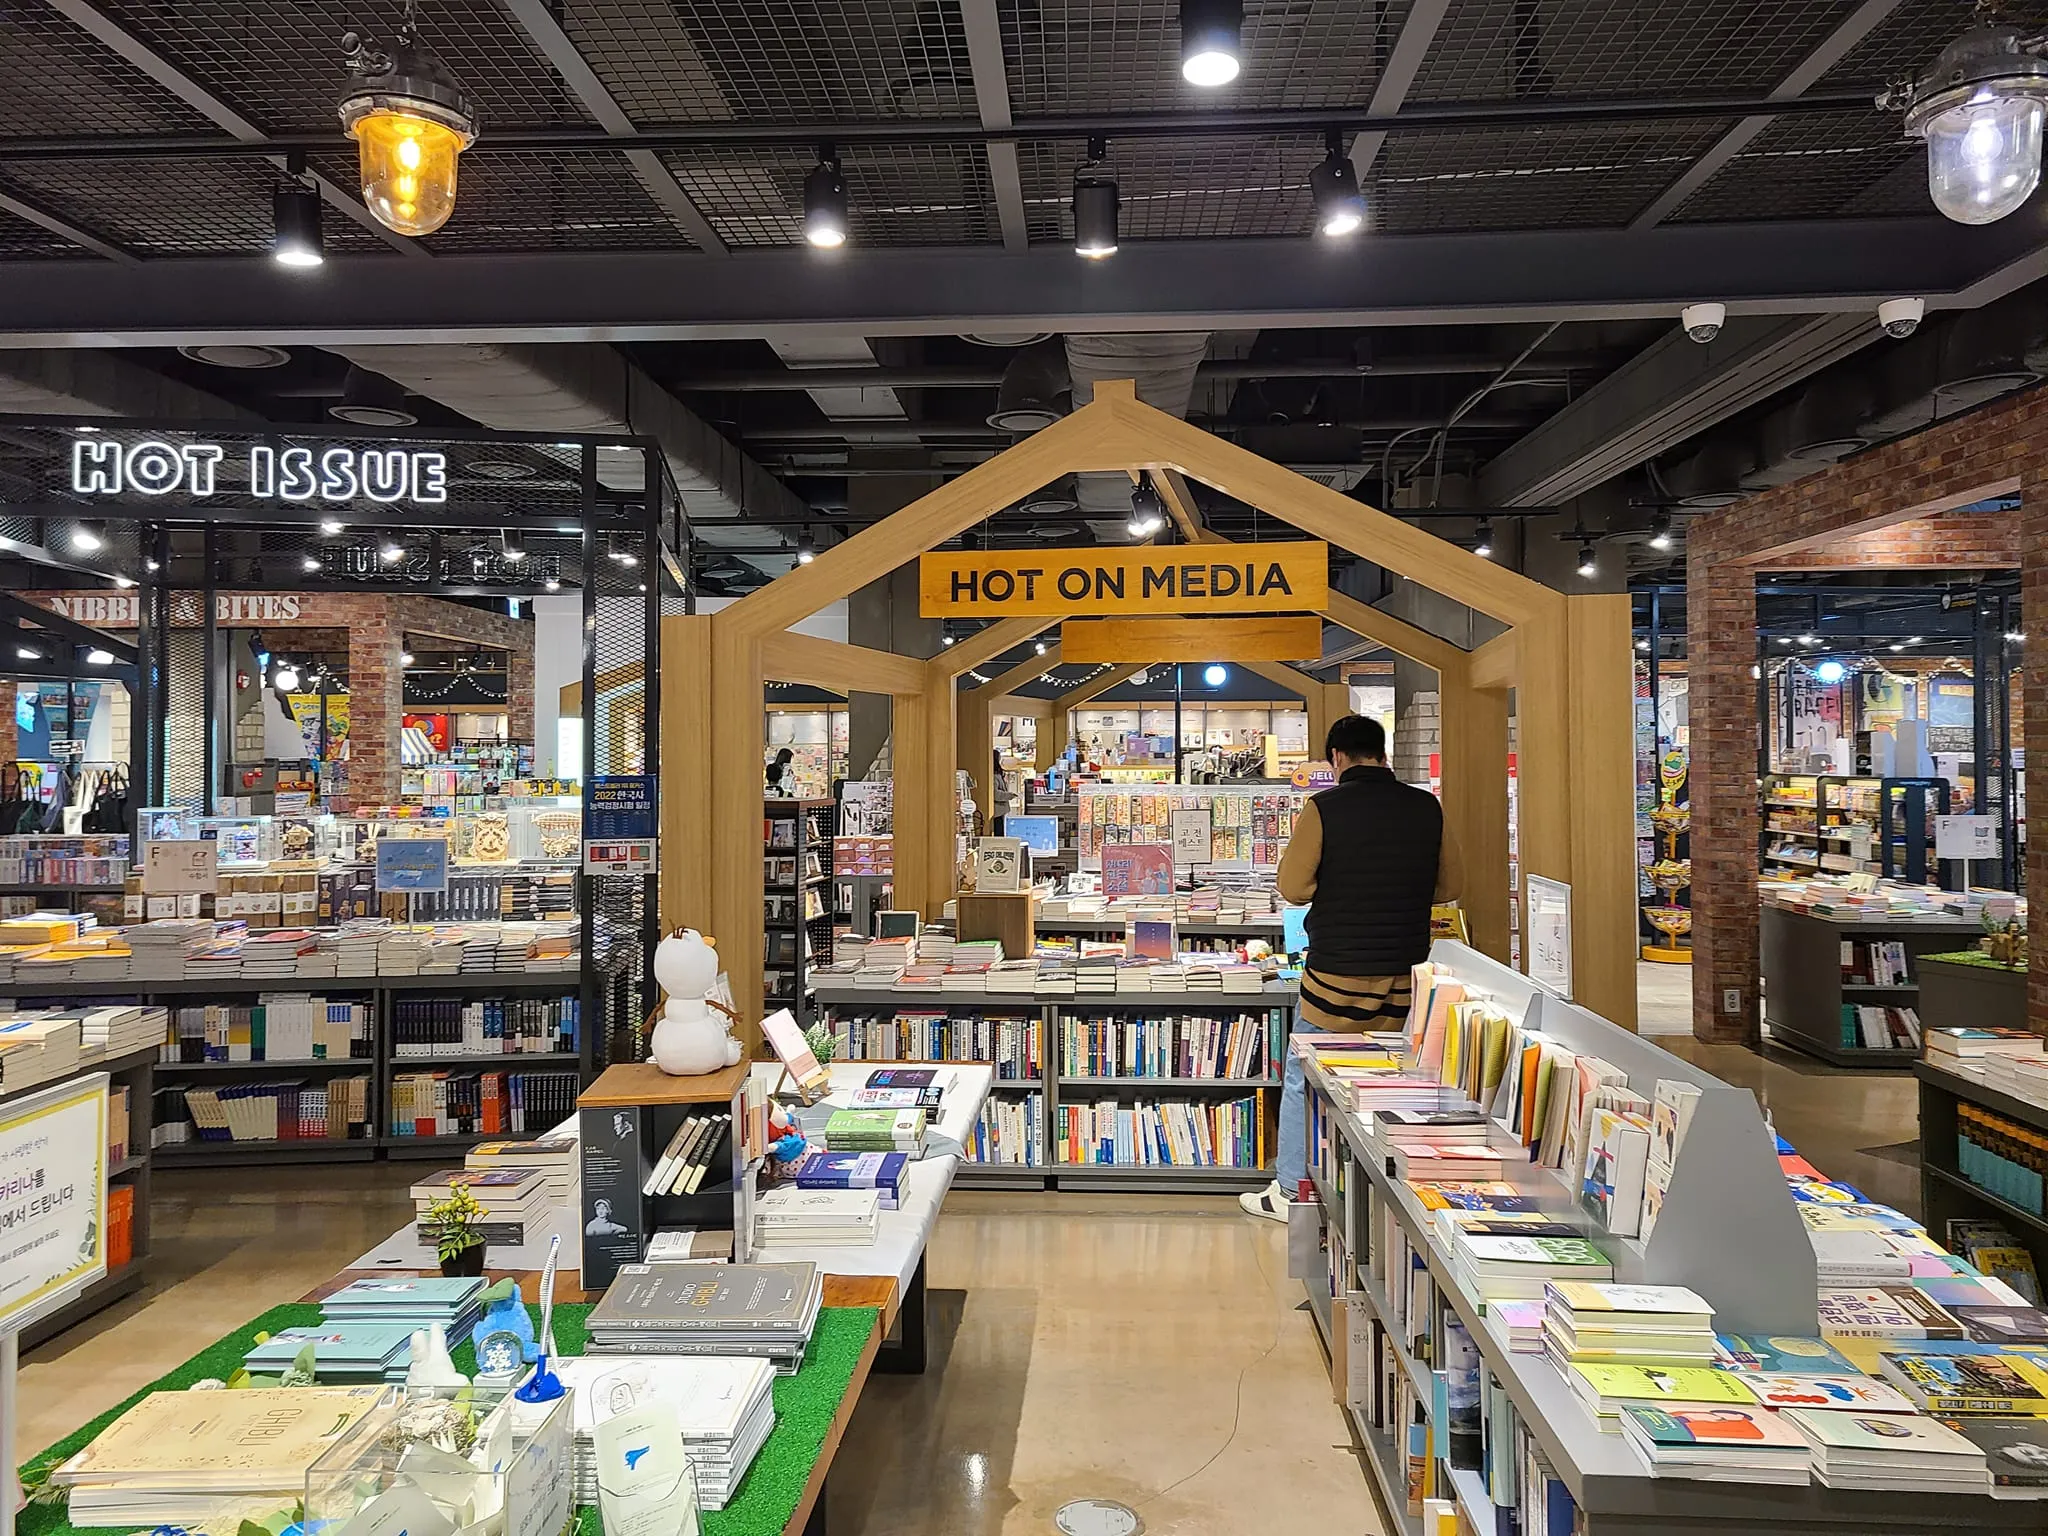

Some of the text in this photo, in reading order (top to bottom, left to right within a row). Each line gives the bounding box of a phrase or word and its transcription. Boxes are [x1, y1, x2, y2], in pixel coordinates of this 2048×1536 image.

[72, 440, 448, 504] HOT ISSUE
[950, 561, 1293, 603] HOT ON MEDIA
[594, 791, 616, 800] 2022
[29, 1183, 75, 1218] 드립니다
[674, 1283, 698, 1305] STUDIO
[690, 1281, 719, 1307] GHIBLI
[236, 1408, 303, 1447] GHIBLI
